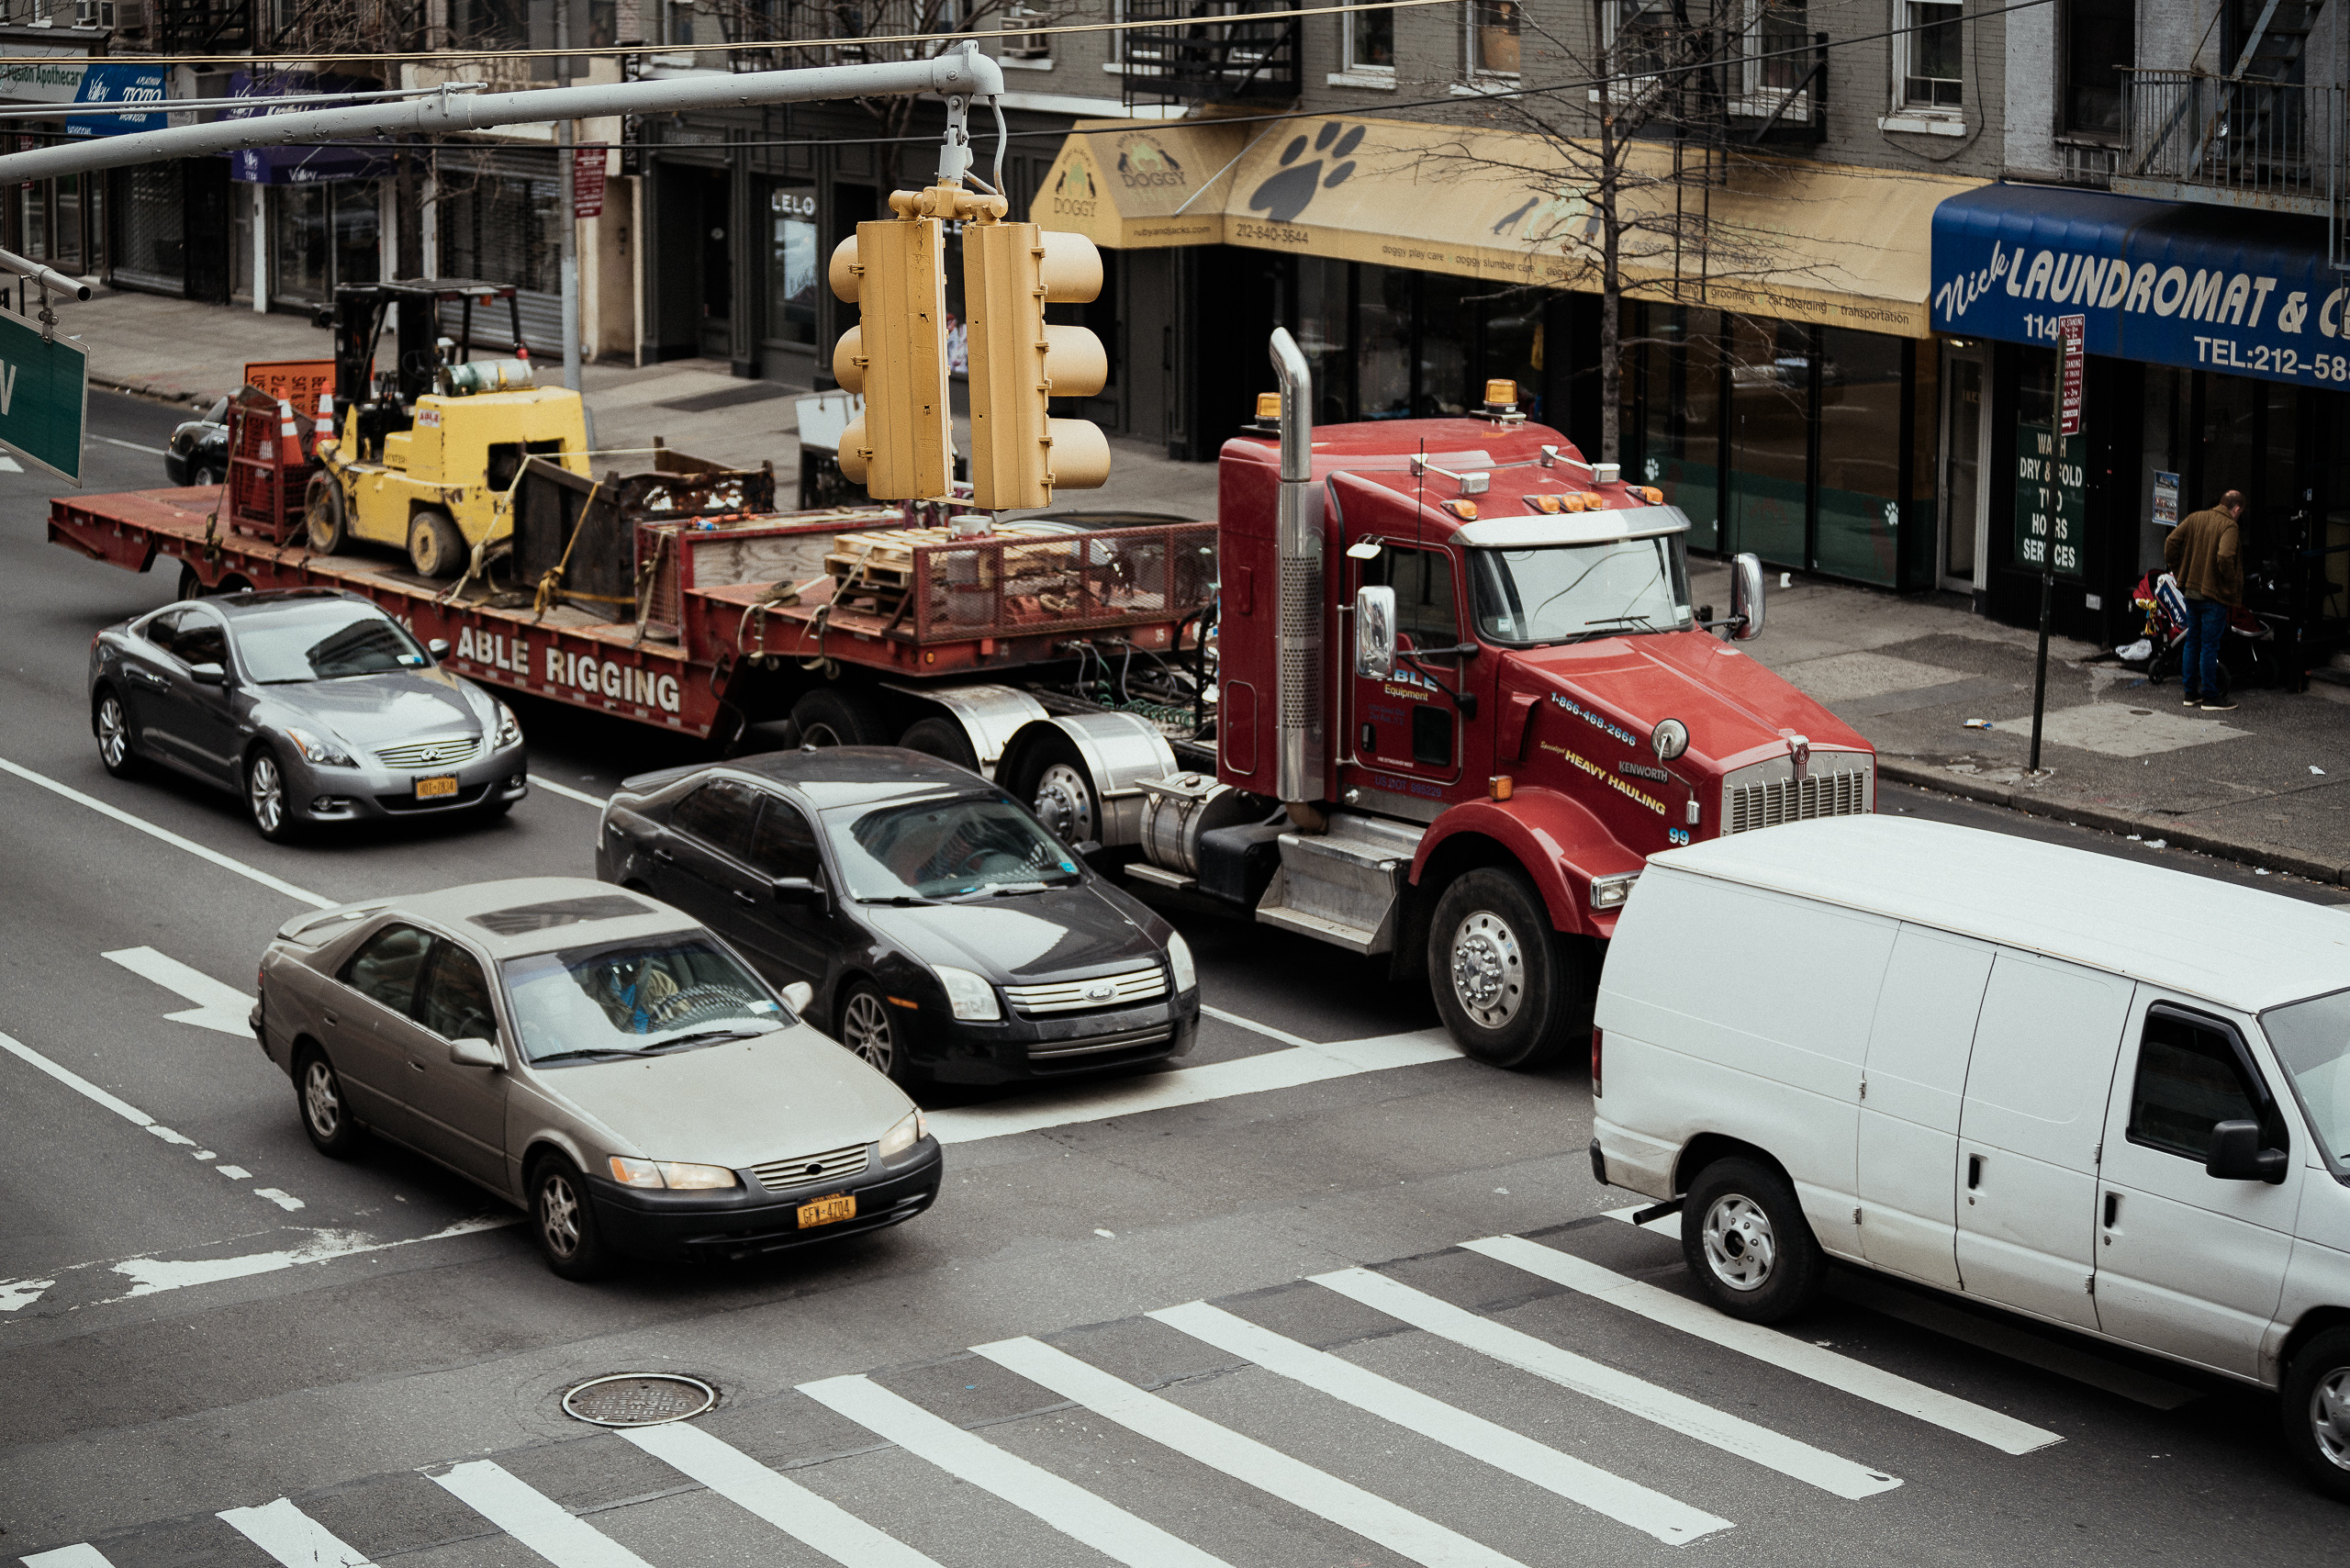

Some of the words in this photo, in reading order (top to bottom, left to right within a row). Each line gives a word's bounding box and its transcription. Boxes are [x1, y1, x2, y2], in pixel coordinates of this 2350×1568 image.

[6, 63, 35, 84] Fusion
[36, 64, 86, 89] Apothecary
[86, 72, 111, 103] Valley
[122, 86, 162, 109] TOTO
[1121, 171, 1187, 188] DOGGY
[771, 193, 816, 217] LELO
[1054, 196, 1098, 218] DOGGY
[1236, 223, 1310, 245] 212-840-3644
[1382, 244, 1406, 259] doggy
[1408, 248, 1426, 262] play
[1427, 251, 1445, 262] care
[1455, 253, 1481, 268] doggy
[1483, 257, 1516, 272] slumber
[1517, 263, 1536, 274] care
[1711, 286, 1755, 304] grooming
[1841, 305, 1909, 325] transportation
[1935, 239, 2009, 322] Nick
[2006, 247, 2277, 328] LAUNDROMAT
[2277, 290, 2308, 334] &
[2194, 336, 2350, 383] TEL:212-58
[419, 412, 440, 423] ABLE
[2037, 432, 2067, 458] WAH
[2020, 456, 2042, 480] DRY
[2059, 463, 2083, 488] OLD
[2039, 487, 2064, 512] TO
[2031, 512, 2068, 540] HORS
[2023, 537, 2076, 569] SERCES
[456, 624, 530, 676] ABLE
[545, 645, 681, 713] RIGGING
[1377, 668, 1438, 693] BLE
[1384, 683, 1428, 702] Equipment
[1550, 691, 1637, 747] 1-866-468-2666
[1539, 740, 1566, 755] Specialized
[1564, 749, 1608, 780] HEAVY
[1607, 774, 1667, 816] HAULING
[1618, 760, 1669, 783] KENWORTH
[1374, 775, 1387, 787] US
[1388, 778, 1407, 790] DOT
[1410, 781, 1442, 798] 995229
[1668, 827, 1691, 846] 99
